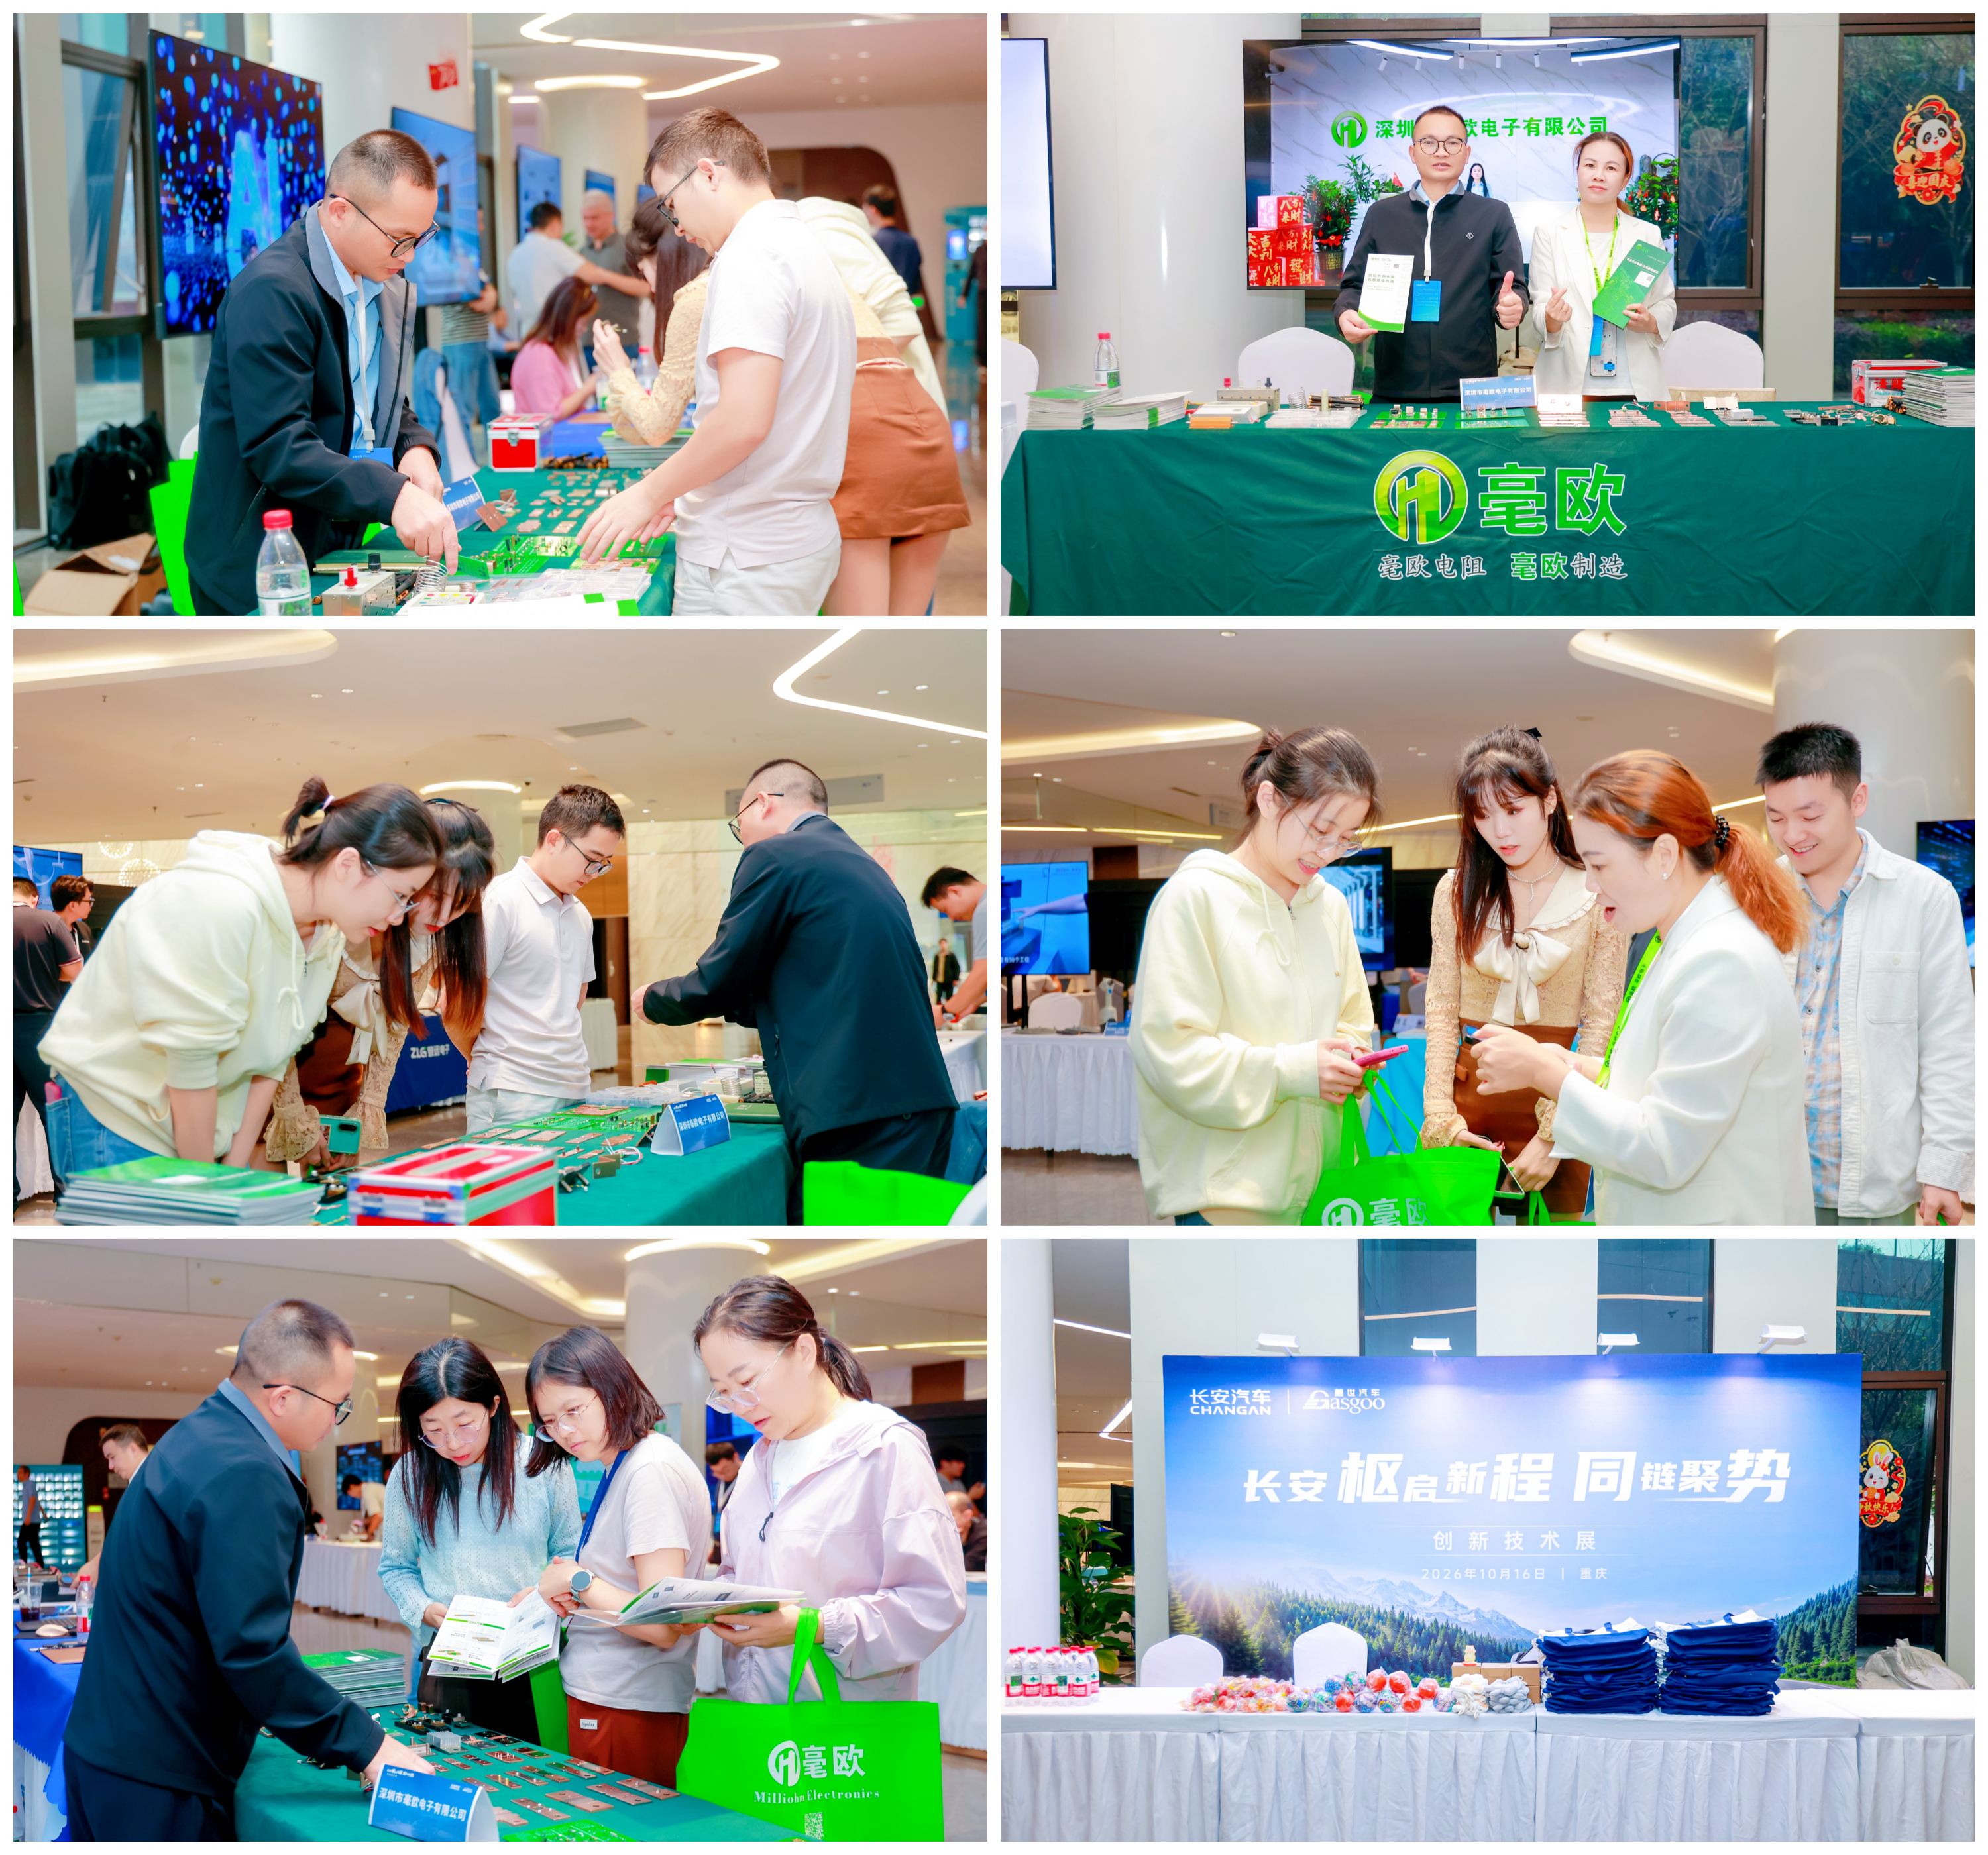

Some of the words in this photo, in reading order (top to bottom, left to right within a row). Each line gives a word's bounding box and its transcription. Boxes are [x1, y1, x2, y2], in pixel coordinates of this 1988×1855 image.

[1375, 117, 1607, 138] 深圳欧电子有限公司
[1906, 173, 1952, 189] 喜迎国庆
[1478, 462, 1627, 537] 毫欧
[1378, 553, 1487, 580] 毫欧电阻
[1511, 551, 1628, 580] 毫欧制造
[410, 1047, 427, 1059] ZLG
[1189, 1389, 1272, 1405] 长安汽车
[1190, 1405, 1271, 1416] CHANGAN
[1244, 1452, 1554, 1503] 长安枢启新程
[1573, 1449, 1791, 1503] 同链聚势
[1432, 1530, 1596, 1551] 创新技术展
[1421, 1567, 1545, 1580] 2026年10月16日
[1579, 1567, 1608, 1580] 重庆
[802, 1744, 865, 1779] 毫欧
[378, 1787, 467, 1822] 深圳市毫欧电子有限公司
[754, 1791, 805, 1804] Milliohm
[806, 1788, 880, 1801] Electronics
